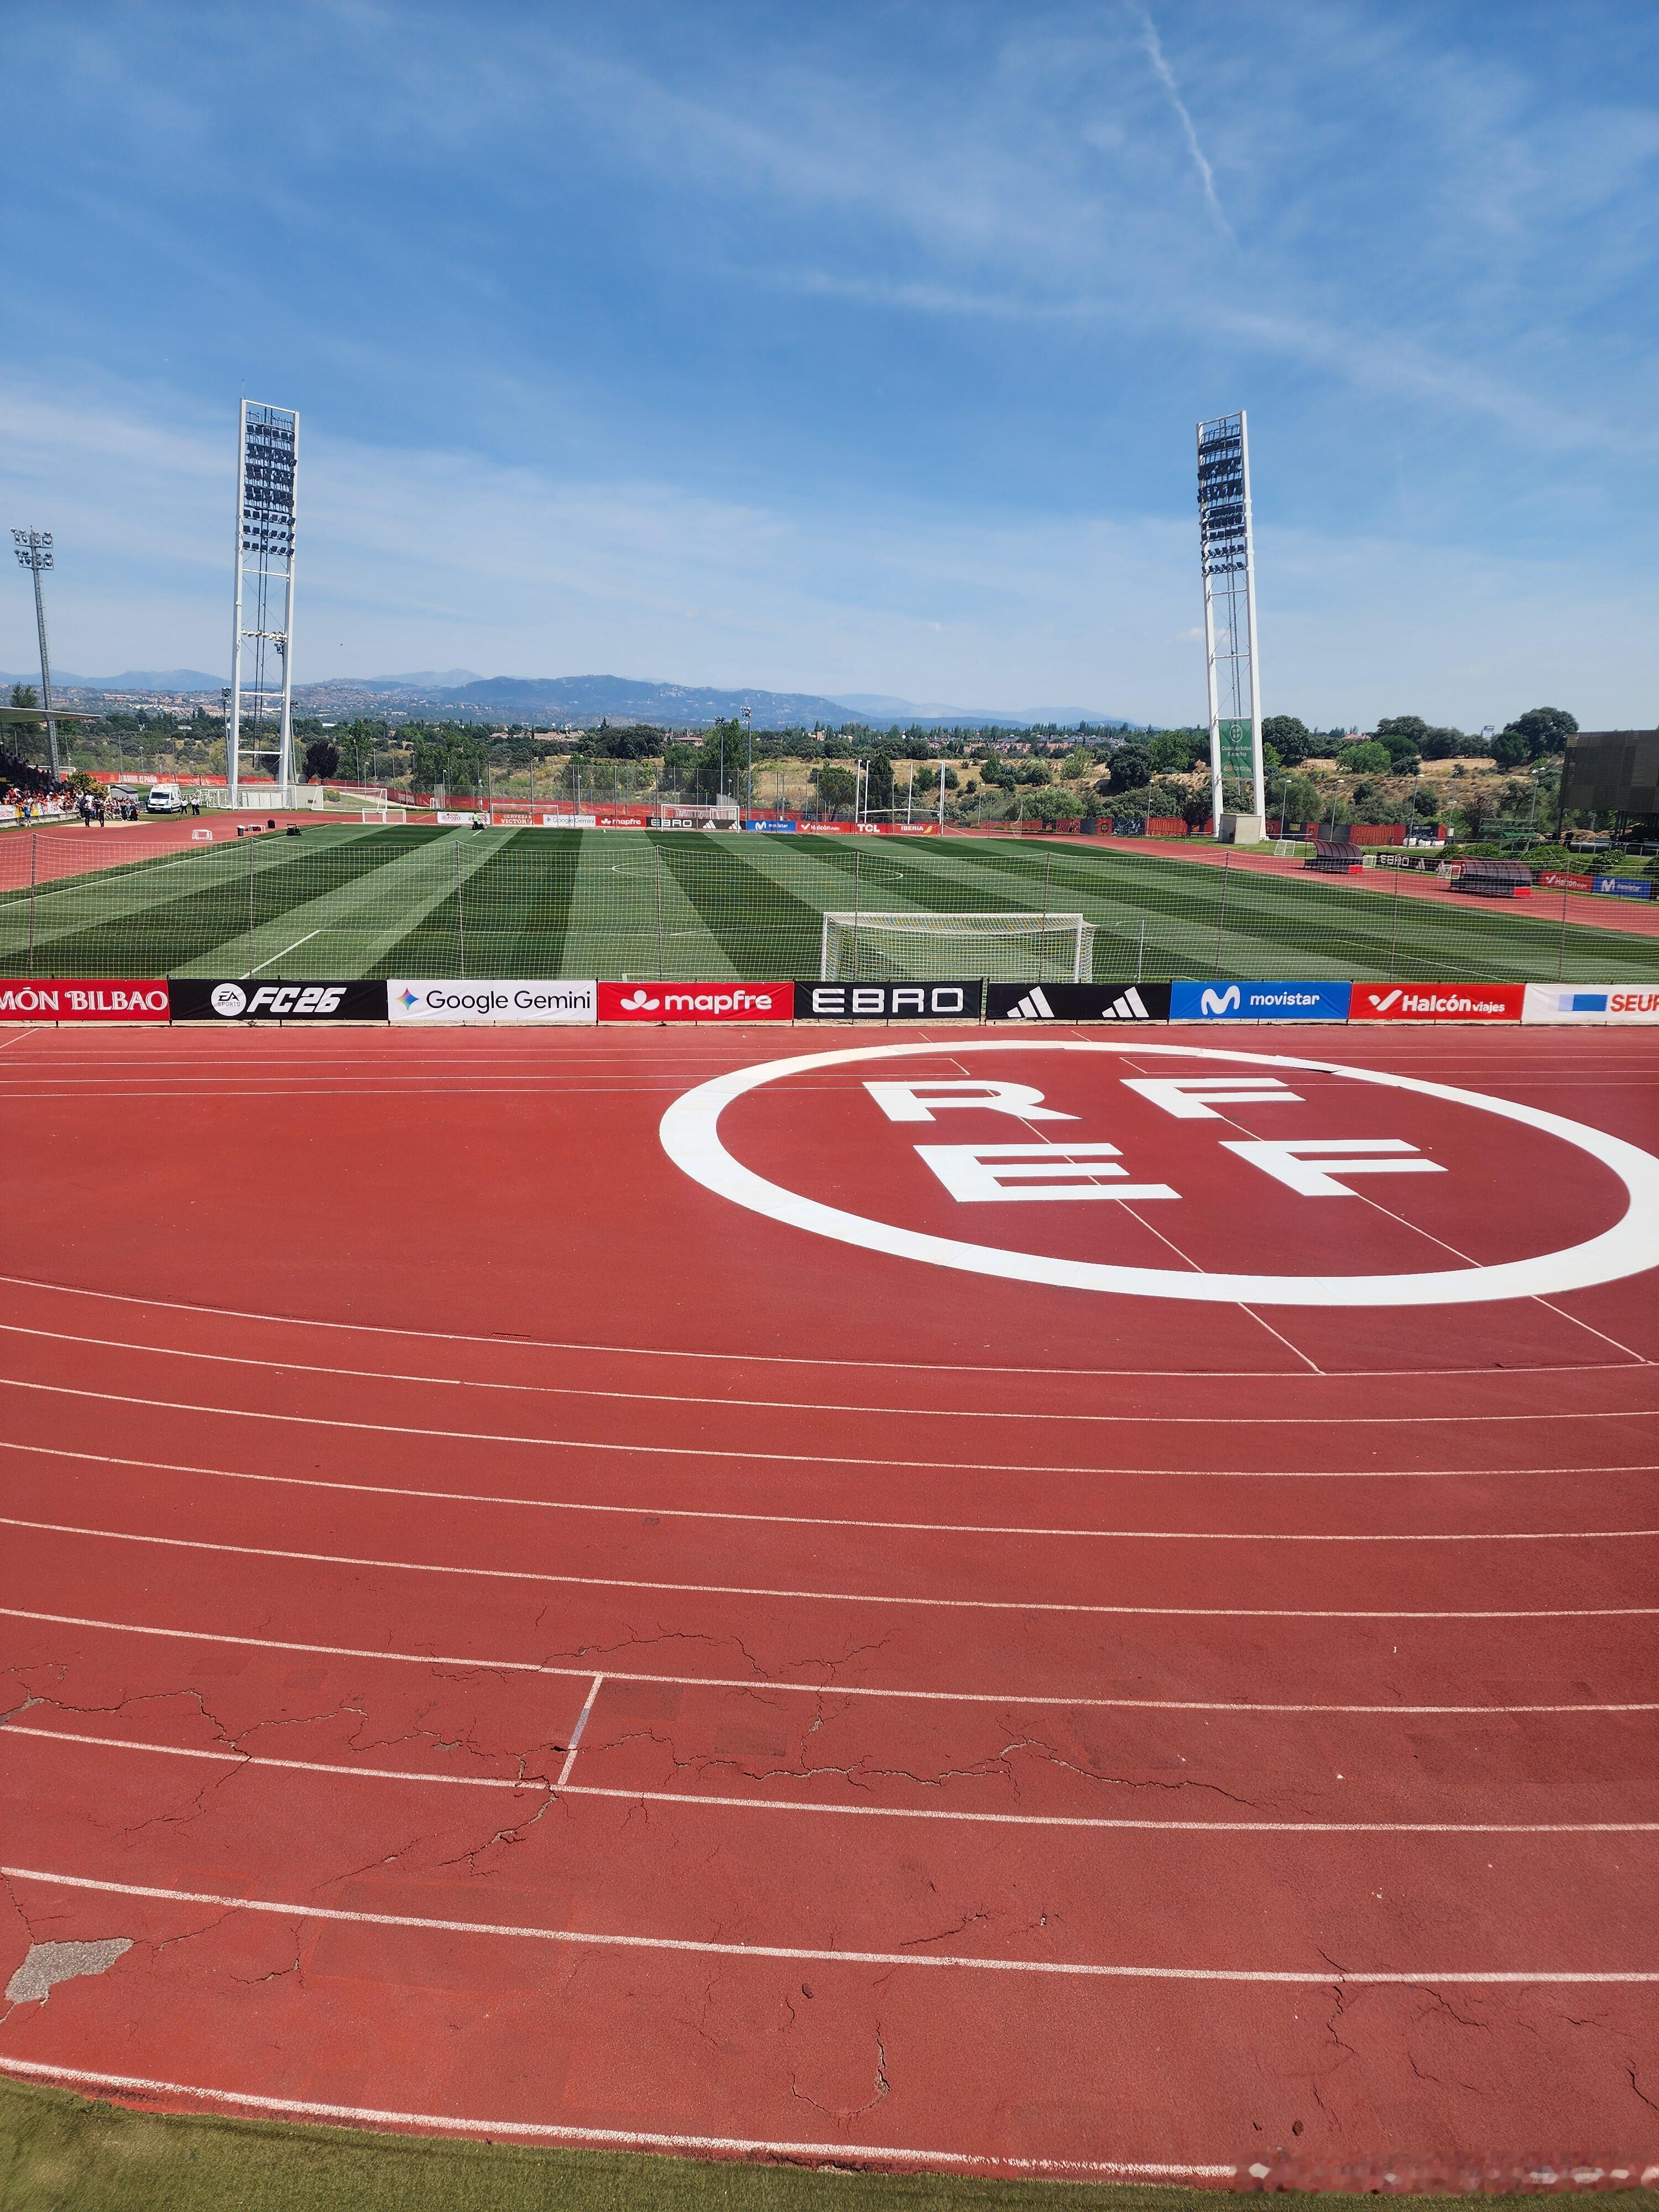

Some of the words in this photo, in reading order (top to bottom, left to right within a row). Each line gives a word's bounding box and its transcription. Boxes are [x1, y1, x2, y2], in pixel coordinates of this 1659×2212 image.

[651, 818, 692, 828] EBRO
[857, 823, 880, 832] TCL
[65, 990, 169, 1011] BILBAO
[217, 991, 239, 1001] EA
[426, 990, 508, 1014] Google
[514, 990, 591, 1010] Gemini
[665, 990, 772, 1015] mapfre
[812, 988, 964, 1013] EBRO
[1250, 991, 1320, 1006] movistar
[1402, 994, 1472, 1012] Halcón
[1472, 1001, 1505, 1014] viajes
